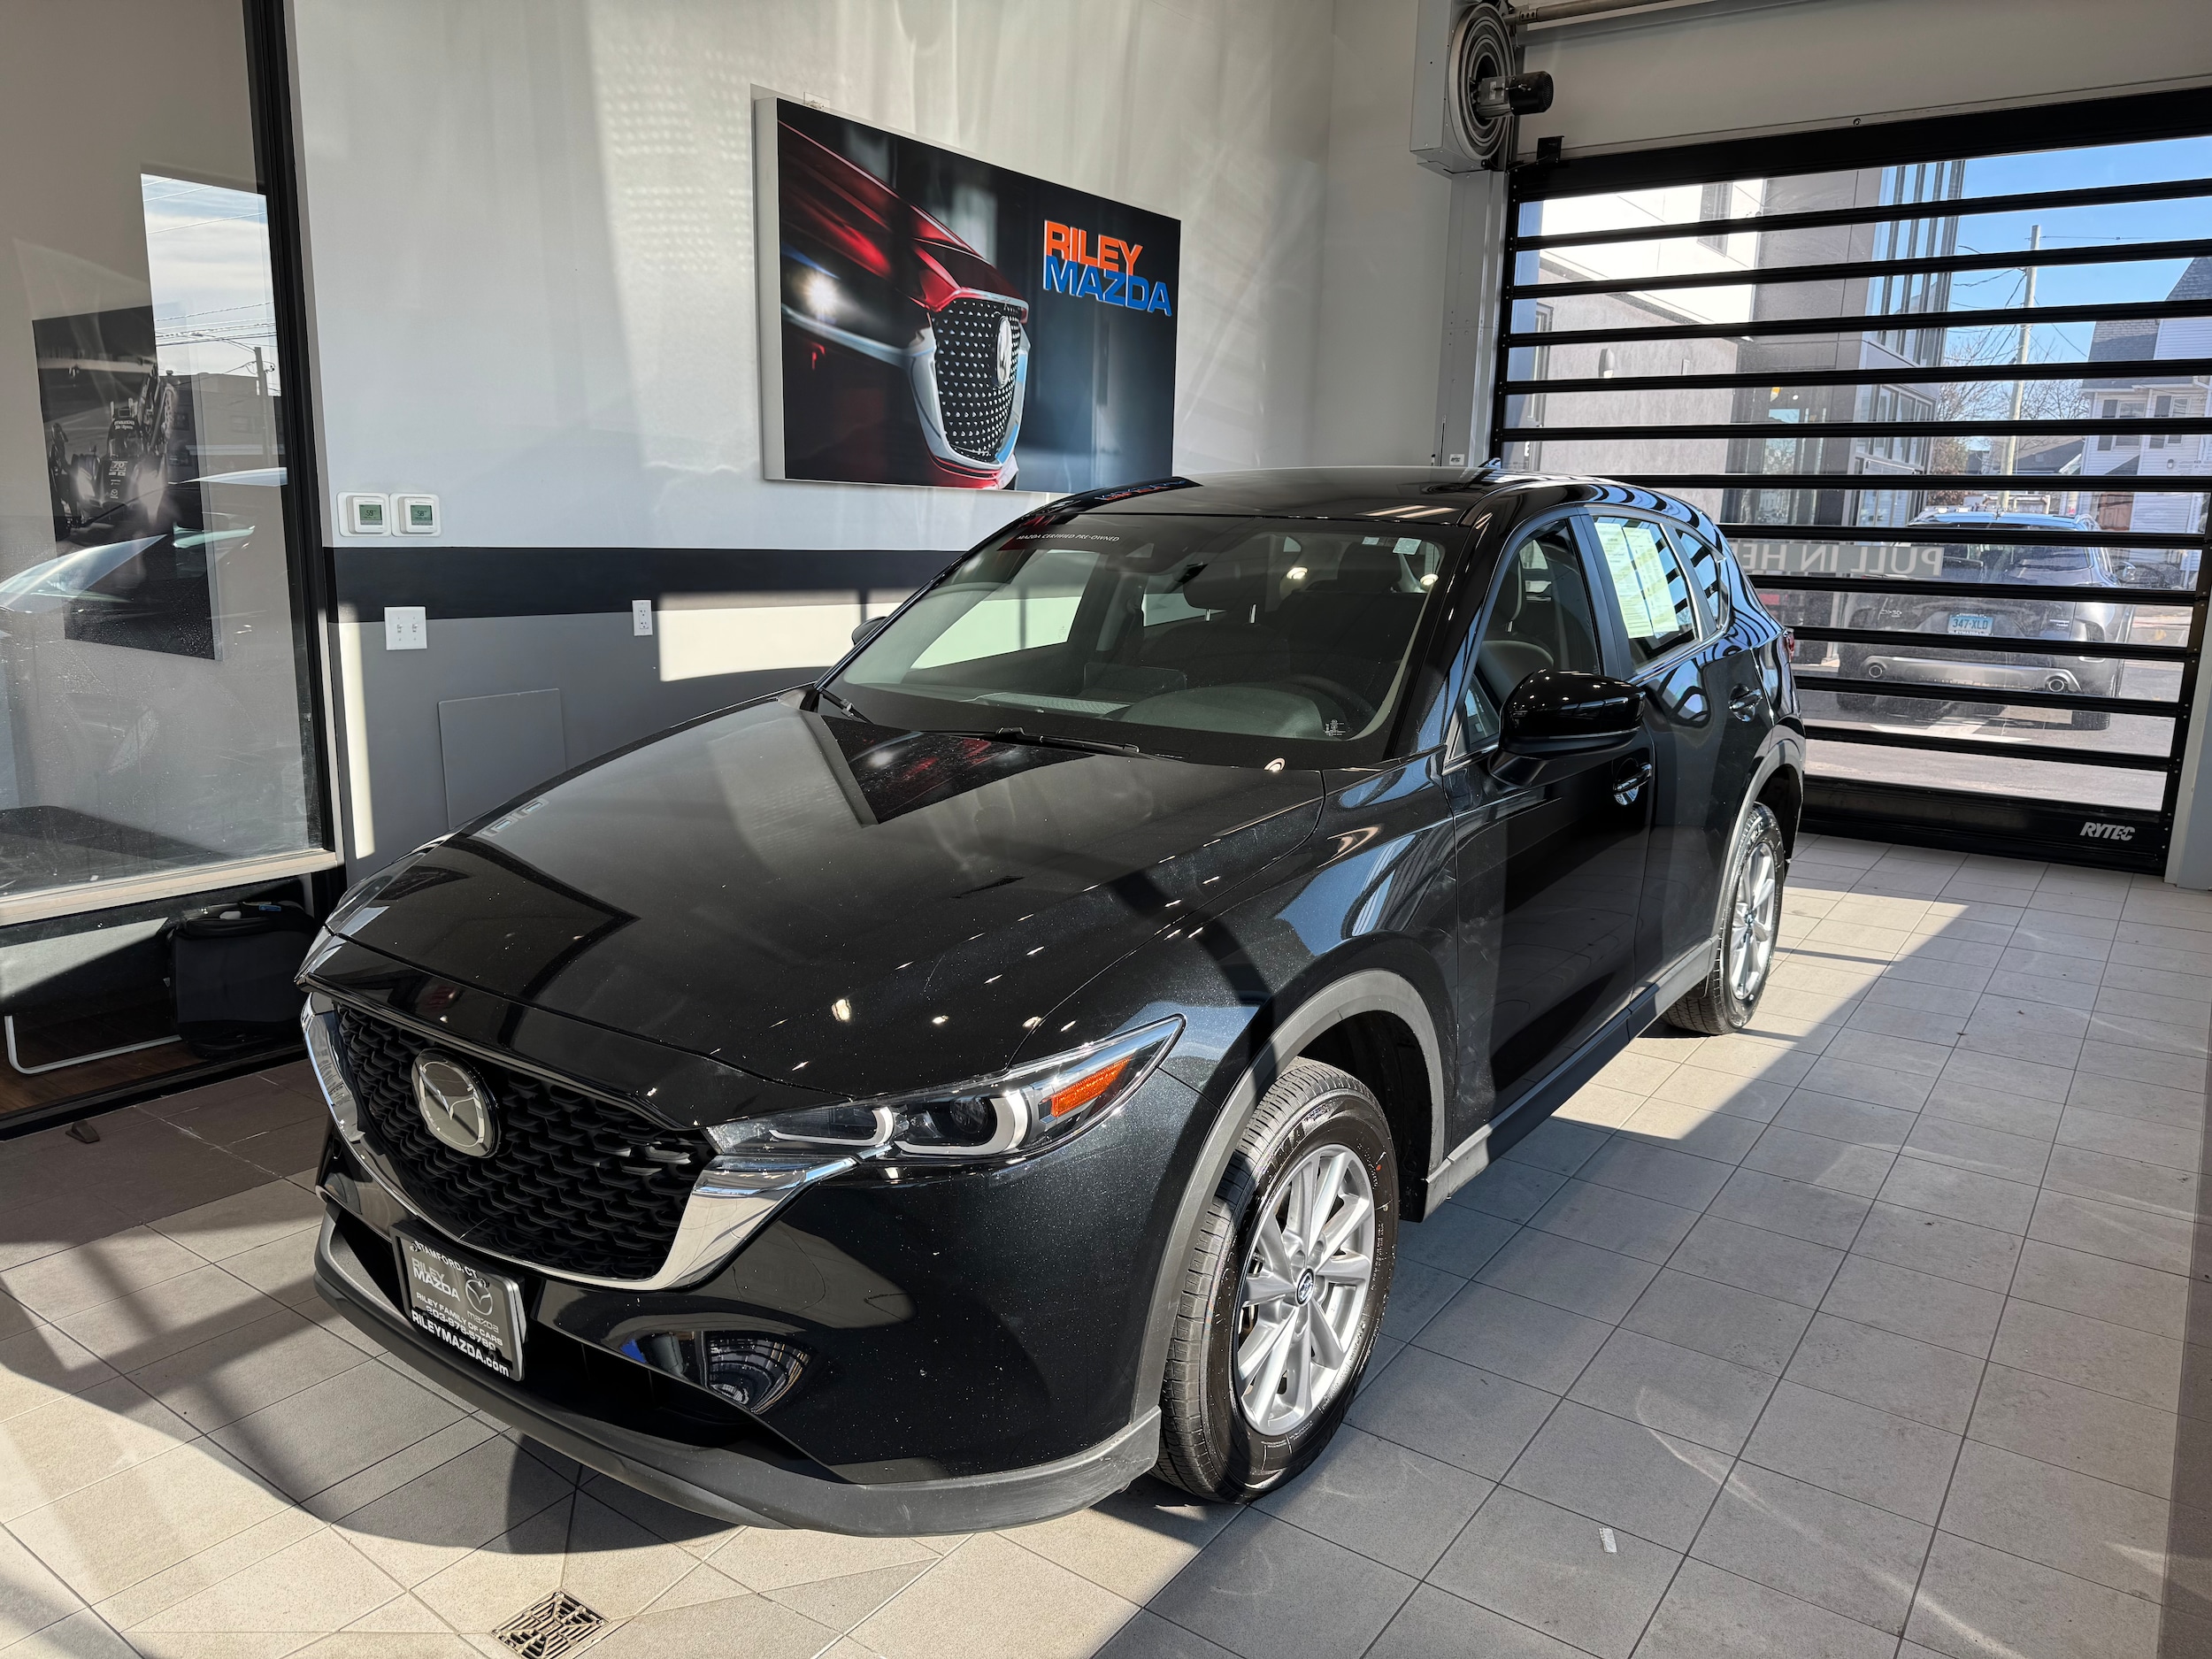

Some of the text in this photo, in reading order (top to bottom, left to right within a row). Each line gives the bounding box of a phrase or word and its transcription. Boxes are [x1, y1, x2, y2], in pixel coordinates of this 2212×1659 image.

[1044, 219, 1143, 276] RILEY
[1042, 255, 1172, 317] MAZDA
[2079, 822, 2135, 841] RYTEC
[411, 1257, 445, 1282] RILEY
[413, 1267, 461, 1302] MAZDA
[465, 1266, 477, 1279] CT
[416, 1292, 503, 1347] RILEY FAMILY OF CARS
[467, 1310, 499, 1334] mazda
[411, 1310, 510, 1378] RILEYMAZDA.com
